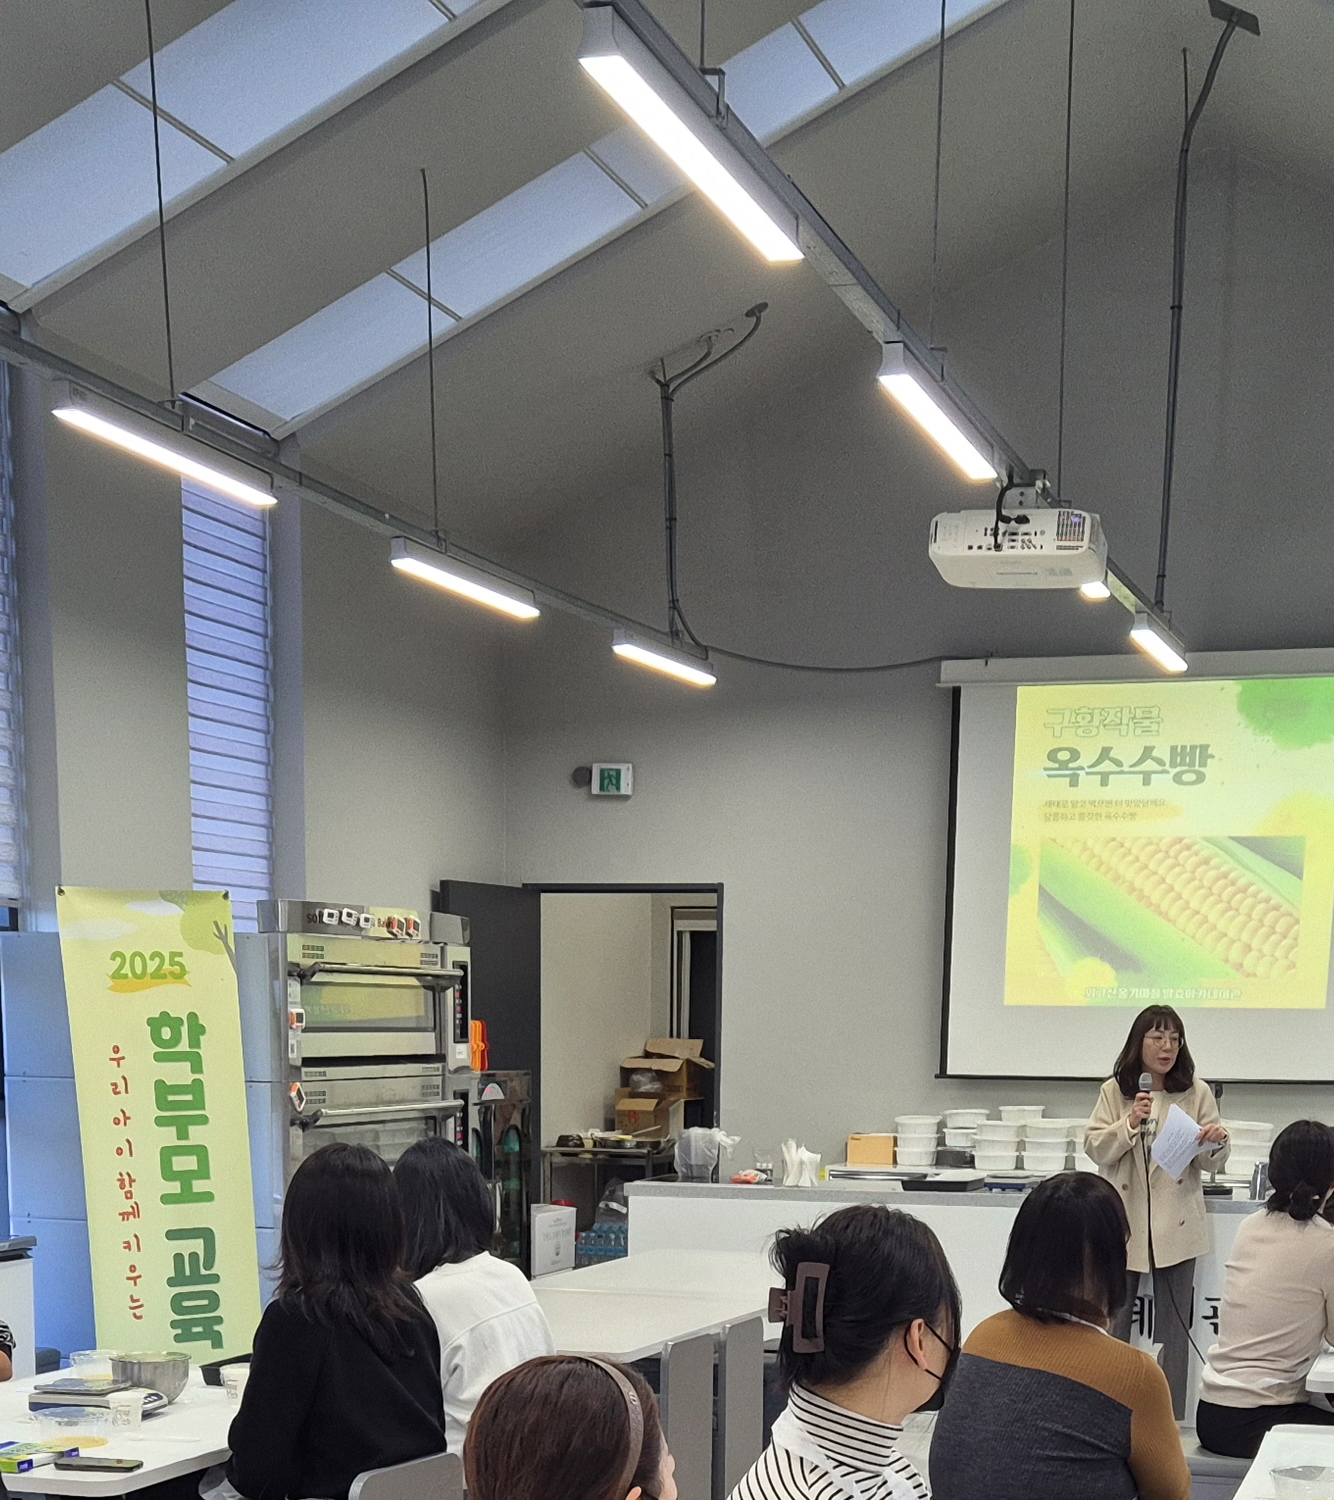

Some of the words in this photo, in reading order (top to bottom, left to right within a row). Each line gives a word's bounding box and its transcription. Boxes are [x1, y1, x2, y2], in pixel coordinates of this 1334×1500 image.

[1044, 706, 1163, 738] 구황작물
[1043, 743, 1216, 788] 옥수수빵
[109, 950, 188, 980] 2025
[109, 1044, 129, 1096] 우리
[147, 1011, 215, 1205] 학부모
[112, 1109, 134, 1158] 아이
[117, 1171, 141, 1221] 함께
[122, 1233, 144, 1320] 키우는
[165, 1226, 225, 1350] 교육
